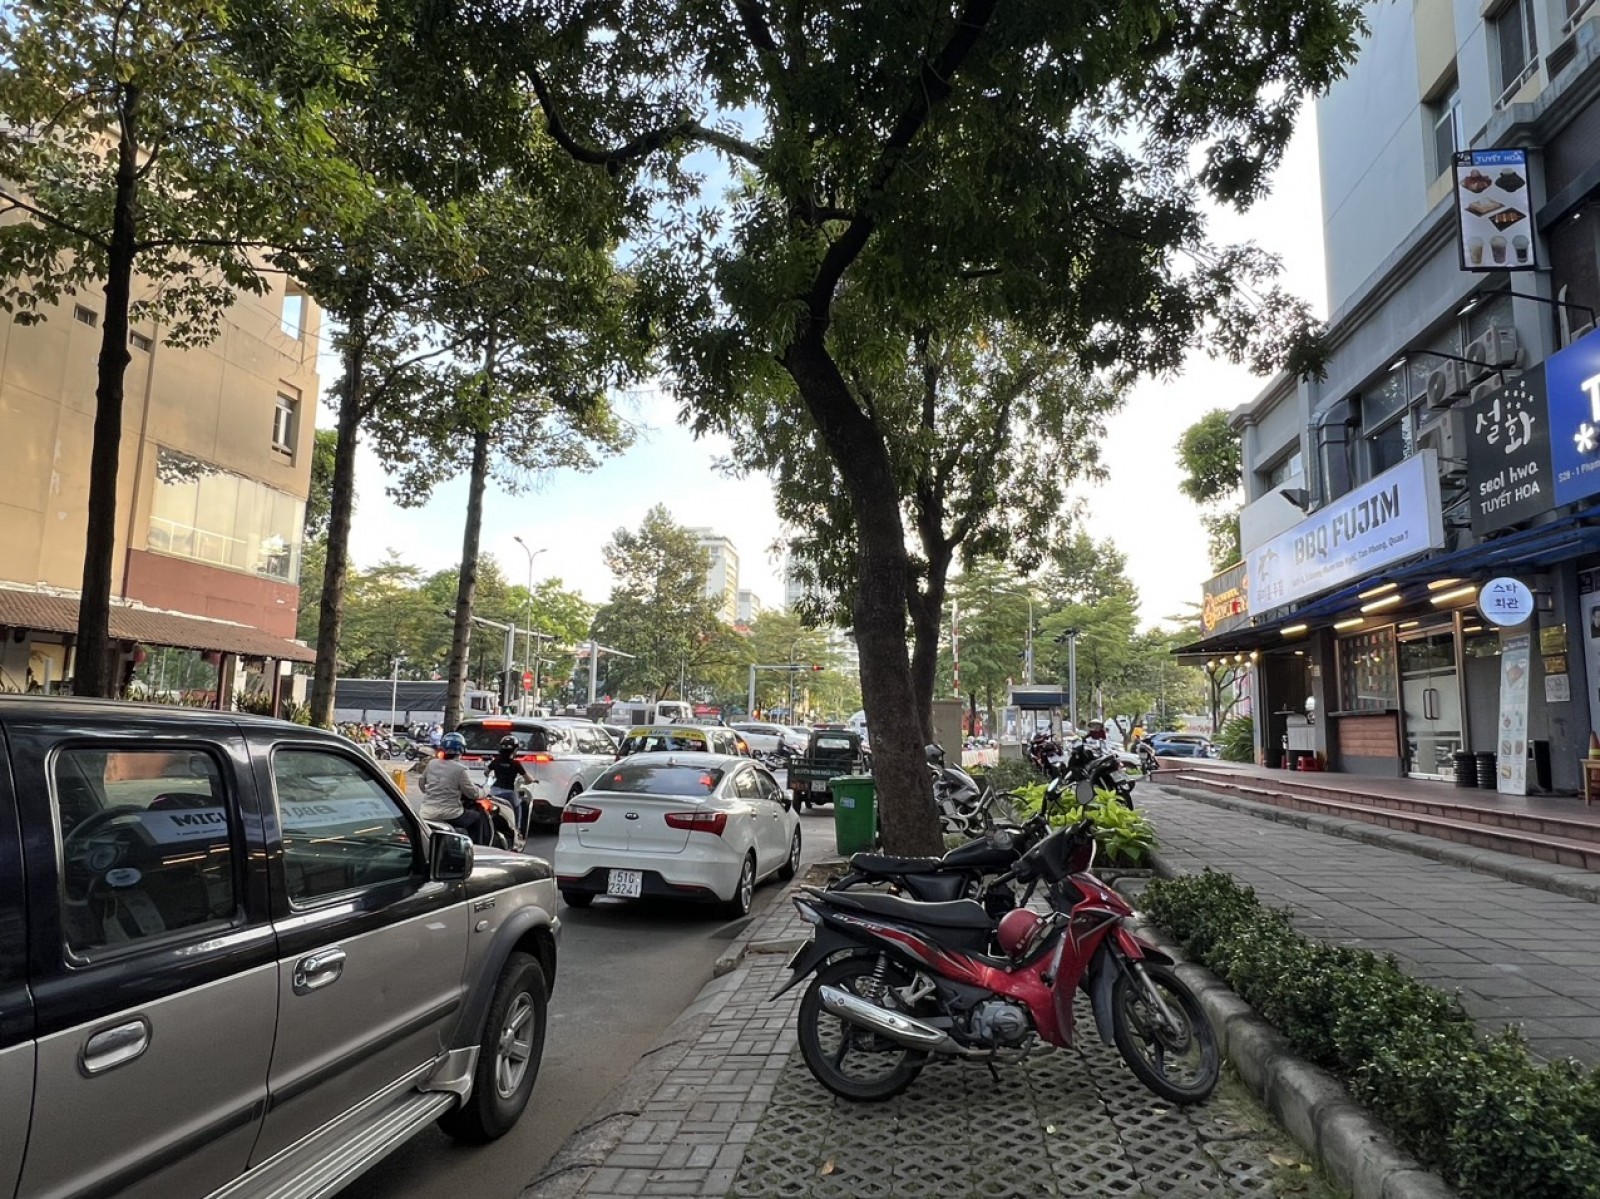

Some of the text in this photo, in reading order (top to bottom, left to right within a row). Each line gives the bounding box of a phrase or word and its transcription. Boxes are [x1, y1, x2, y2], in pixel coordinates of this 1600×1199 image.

[1509, 461, 1539, 484] hwa
[1515, 481, 1541, 501] HOA
[1294, 483, 1400, 565] BBQ FUJIM
[1492, 583, 1518, 594] 스타
